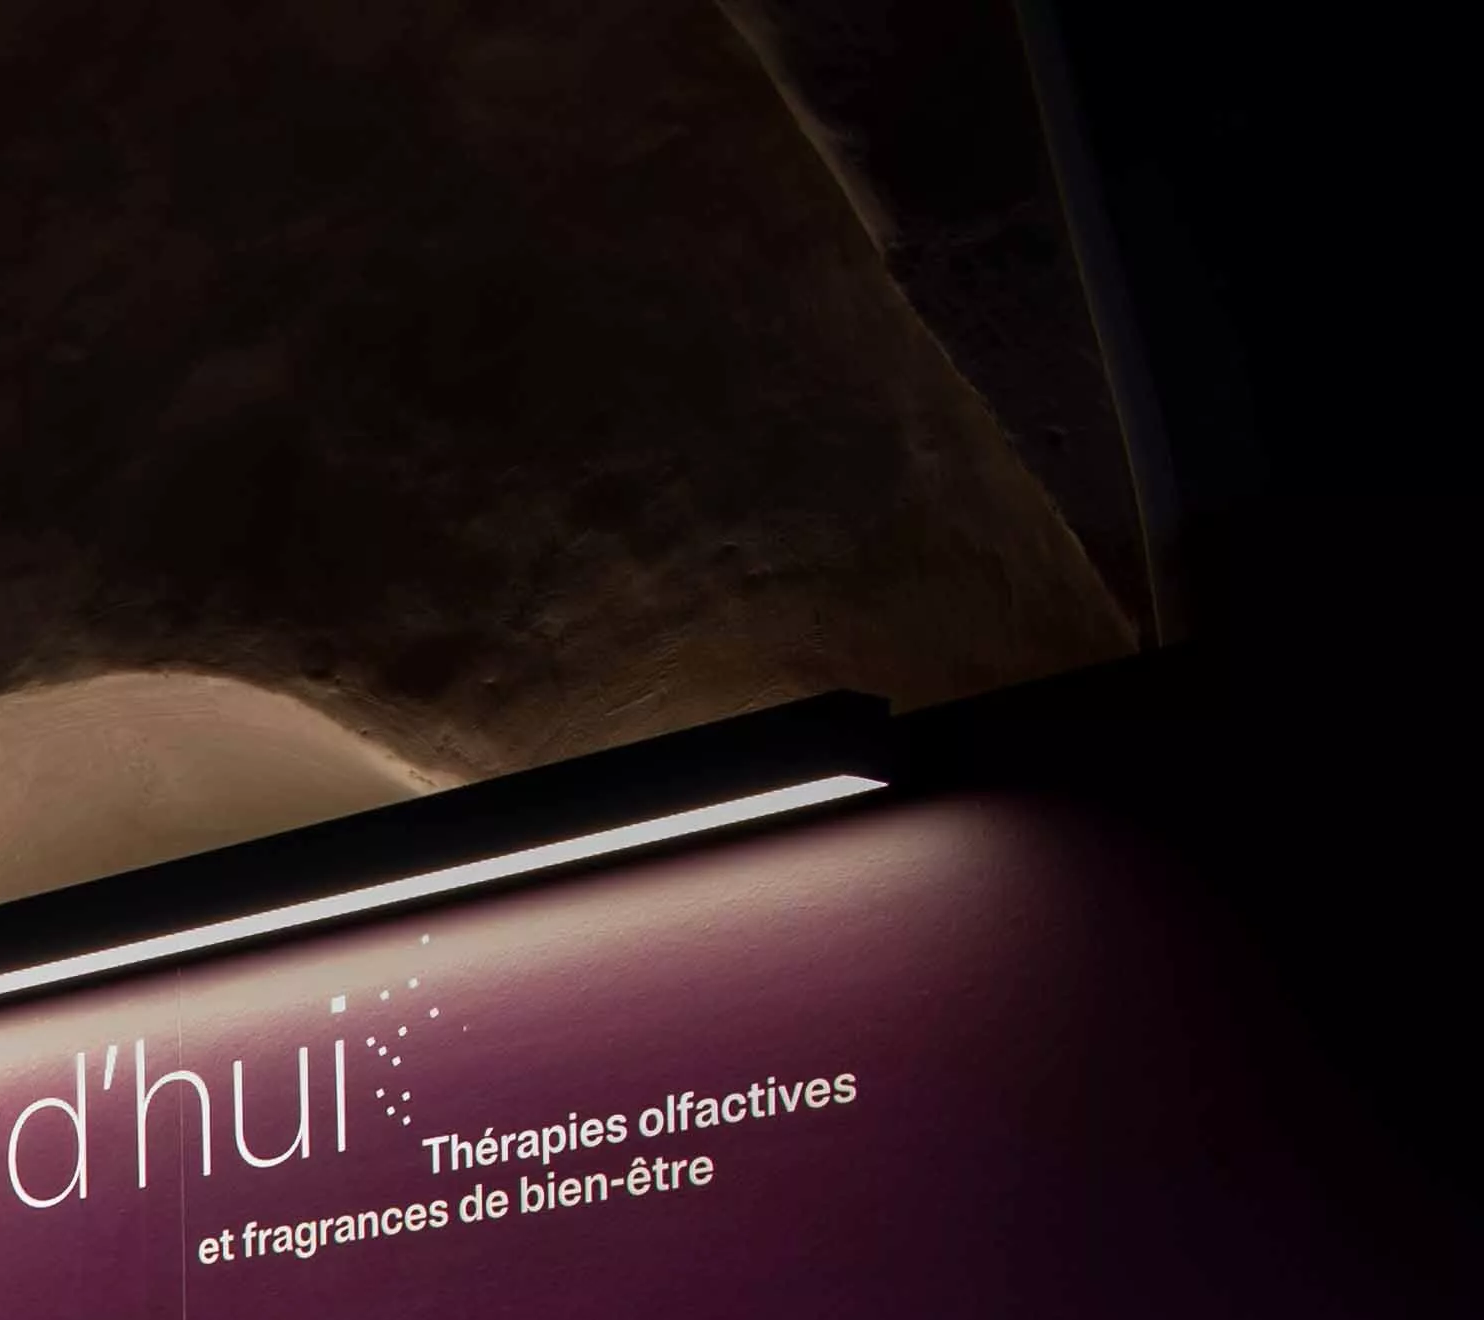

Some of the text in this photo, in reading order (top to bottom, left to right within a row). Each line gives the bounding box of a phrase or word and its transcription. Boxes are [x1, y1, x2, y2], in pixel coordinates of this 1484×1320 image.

[422, 1073, 857, 1174] Thérapies olfactives
[198, 1156, 714, 1264] et fragrances de bien-être
